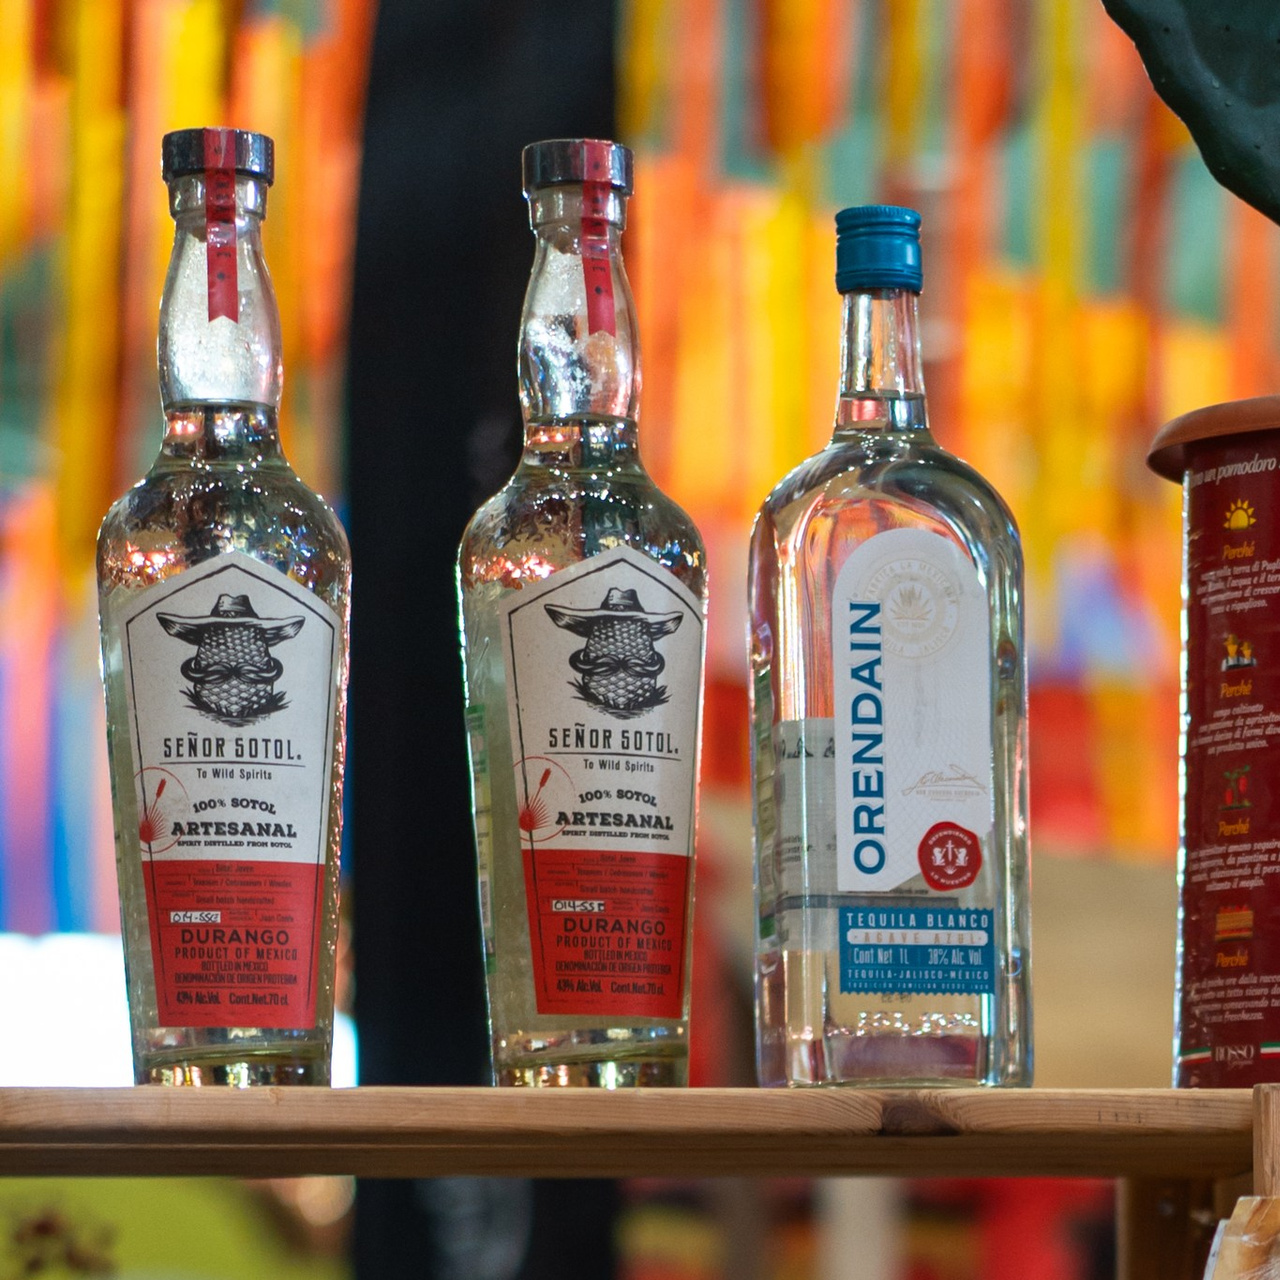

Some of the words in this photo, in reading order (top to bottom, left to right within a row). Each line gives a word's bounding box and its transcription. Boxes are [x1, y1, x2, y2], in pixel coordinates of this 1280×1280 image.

[1216, 453, 1277, 485] pomodoro
[549, 722, 612, 749] SEÑOR
[850, 601, 886, 875] ORENDAIN
[163, 731, 225, 758] SEÑOR
[584, 758, 594, 770] To
[599, 759, 621, 771] Wild
[625, 761, 654, 773] Spirits
[197, 768, 207, 779] To
[212, 768, 235, 780] Wild
[240, 769, 272, 781] Spirits
[192, 798, 226, 813] 100%
[230, 798, 277, 815] SOTOL
[579, 790, 612, 804] 100%
[616, 789, 658, 807] SOTOL
[171, 821, 297, 838] ARTESANAL
[555, 811, 674, 831] ARTESANAL
[247, 840, 269, 848] FROM
[563, 918, 666, 936] DURANGO
[847, 913, 916, 928] TEQUILA
[927, 914, 989, 928] BLANCO
[181, 928, 289, 946] DURANGO
[556, 935, 611, 948] PRODUCT
[618, 936, 632, 948] OF
[637, 938, 672, 951] MEXICO
[864, 932, 920, 944] AGAVE
[934, 932, 975, 944] AZUL
[175, 947, 229, 960] PRODUCT
[235, 947, 250, 960] OF
[256, 948, 298, 961] MEXICO
[928, 948, 948, 965] 38%
